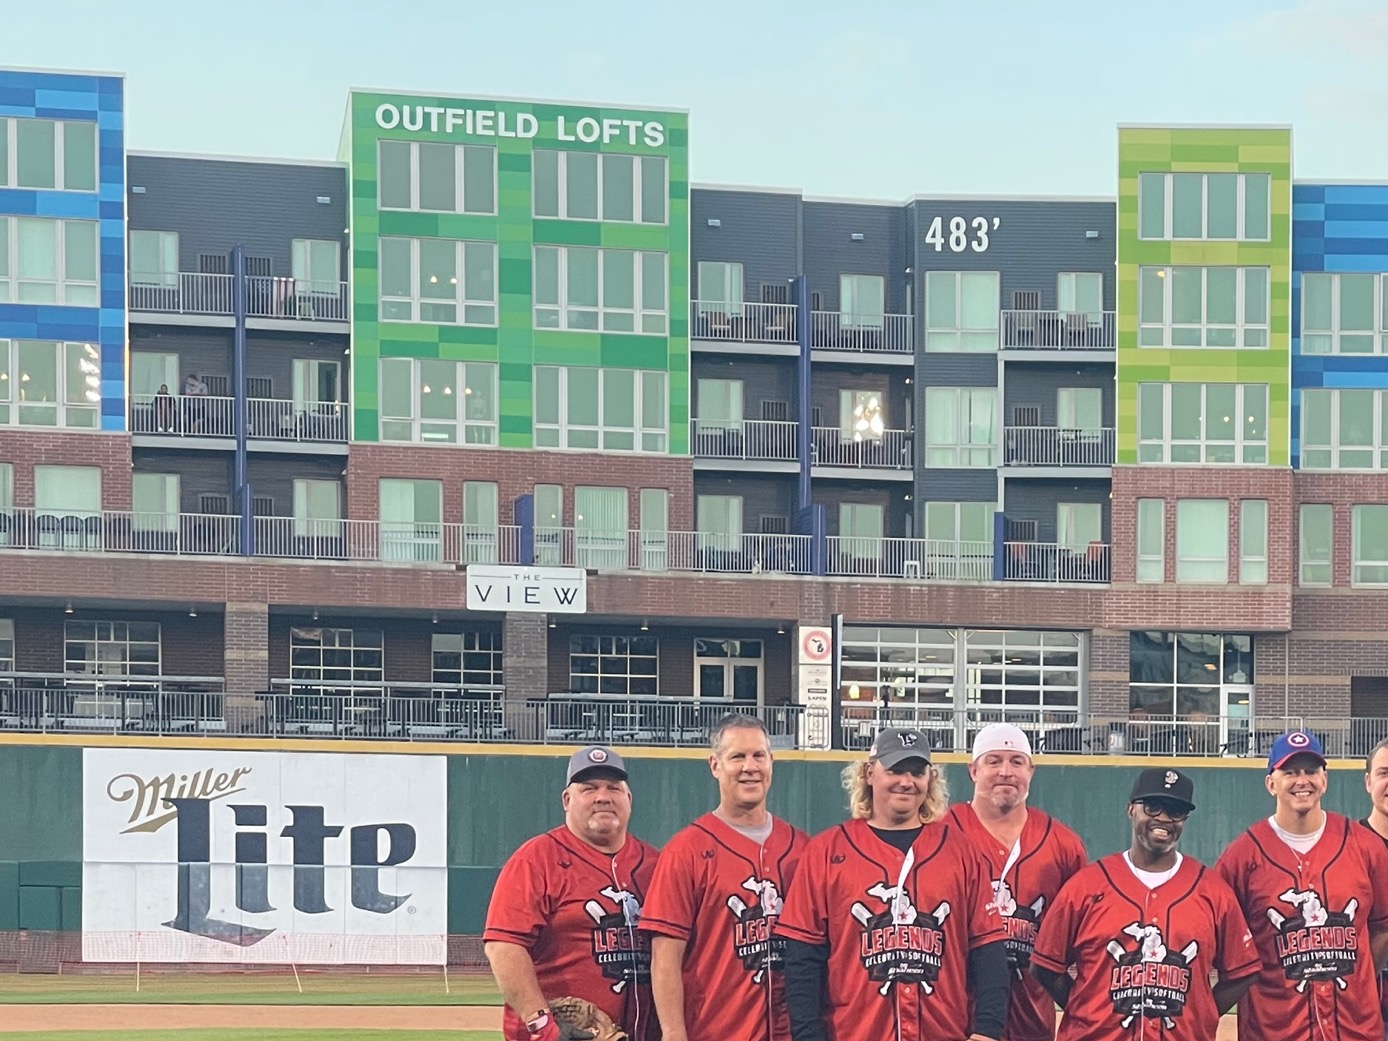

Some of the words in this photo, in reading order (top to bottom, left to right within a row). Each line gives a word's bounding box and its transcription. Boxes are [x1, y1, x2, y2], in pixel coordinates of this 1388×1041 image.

[375, 103, 539, 139] OUTFIELD
[557, 115, 665, 147] LOFTS
[925, 216, 1001, 252] 483'
[475, 584, 579, 605] VIEW
[107, 767, 252, 828] Miller
[160, 797, 417, 947] Lite
[862, 926, 942, 957] LEGENDS
[1277, 926, 1357, 957] LEGENDS
[1111, 963, 1189, 992] LEGENDS
